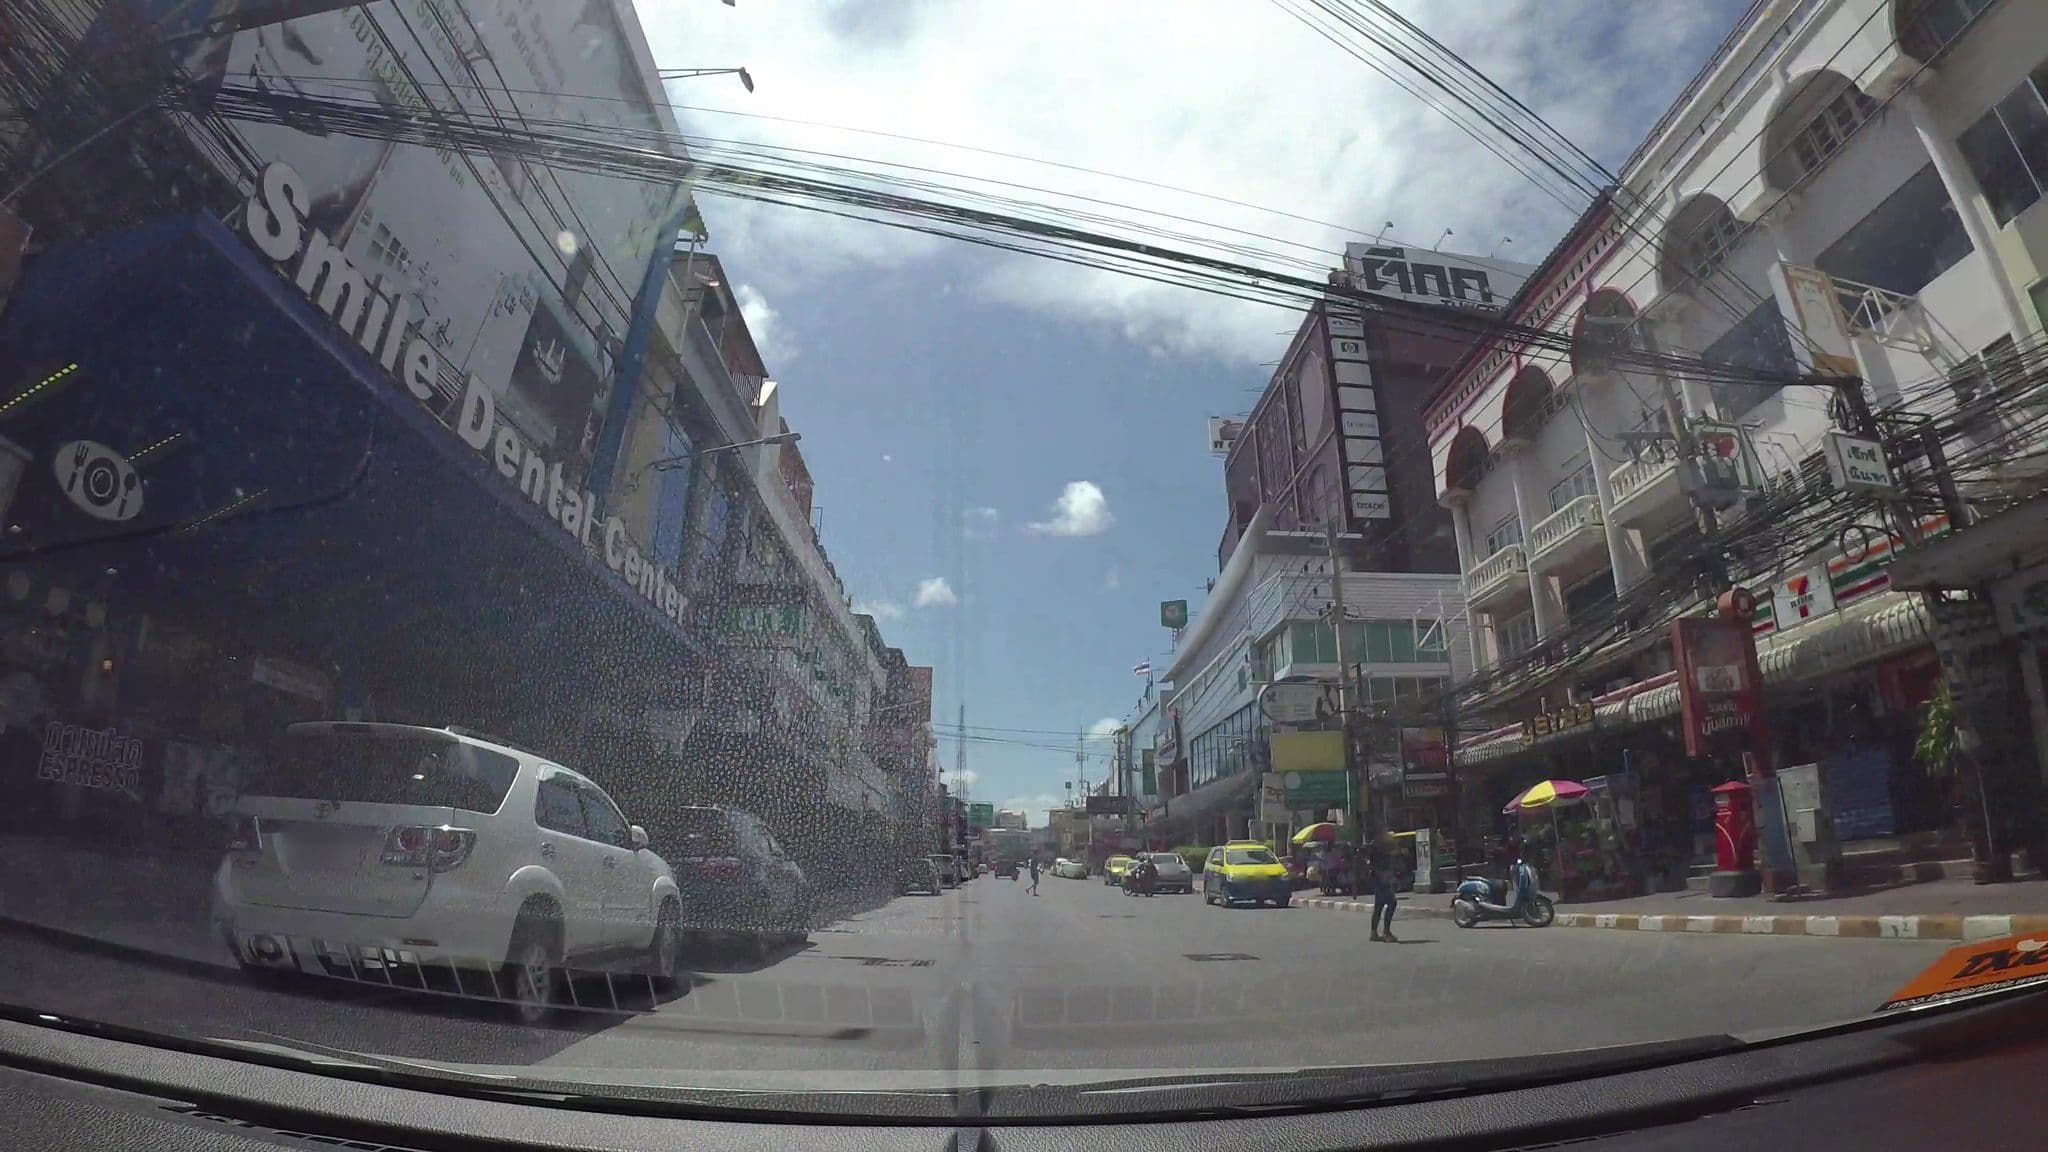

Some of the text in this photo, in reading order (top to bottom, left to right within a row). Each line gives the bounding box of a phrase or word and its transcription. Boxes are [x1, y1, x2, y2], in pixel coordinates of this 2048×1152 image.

[247, 161, 689, 625] Smile Dental Center
[38, 750, 143, 790] ESPRESSO
